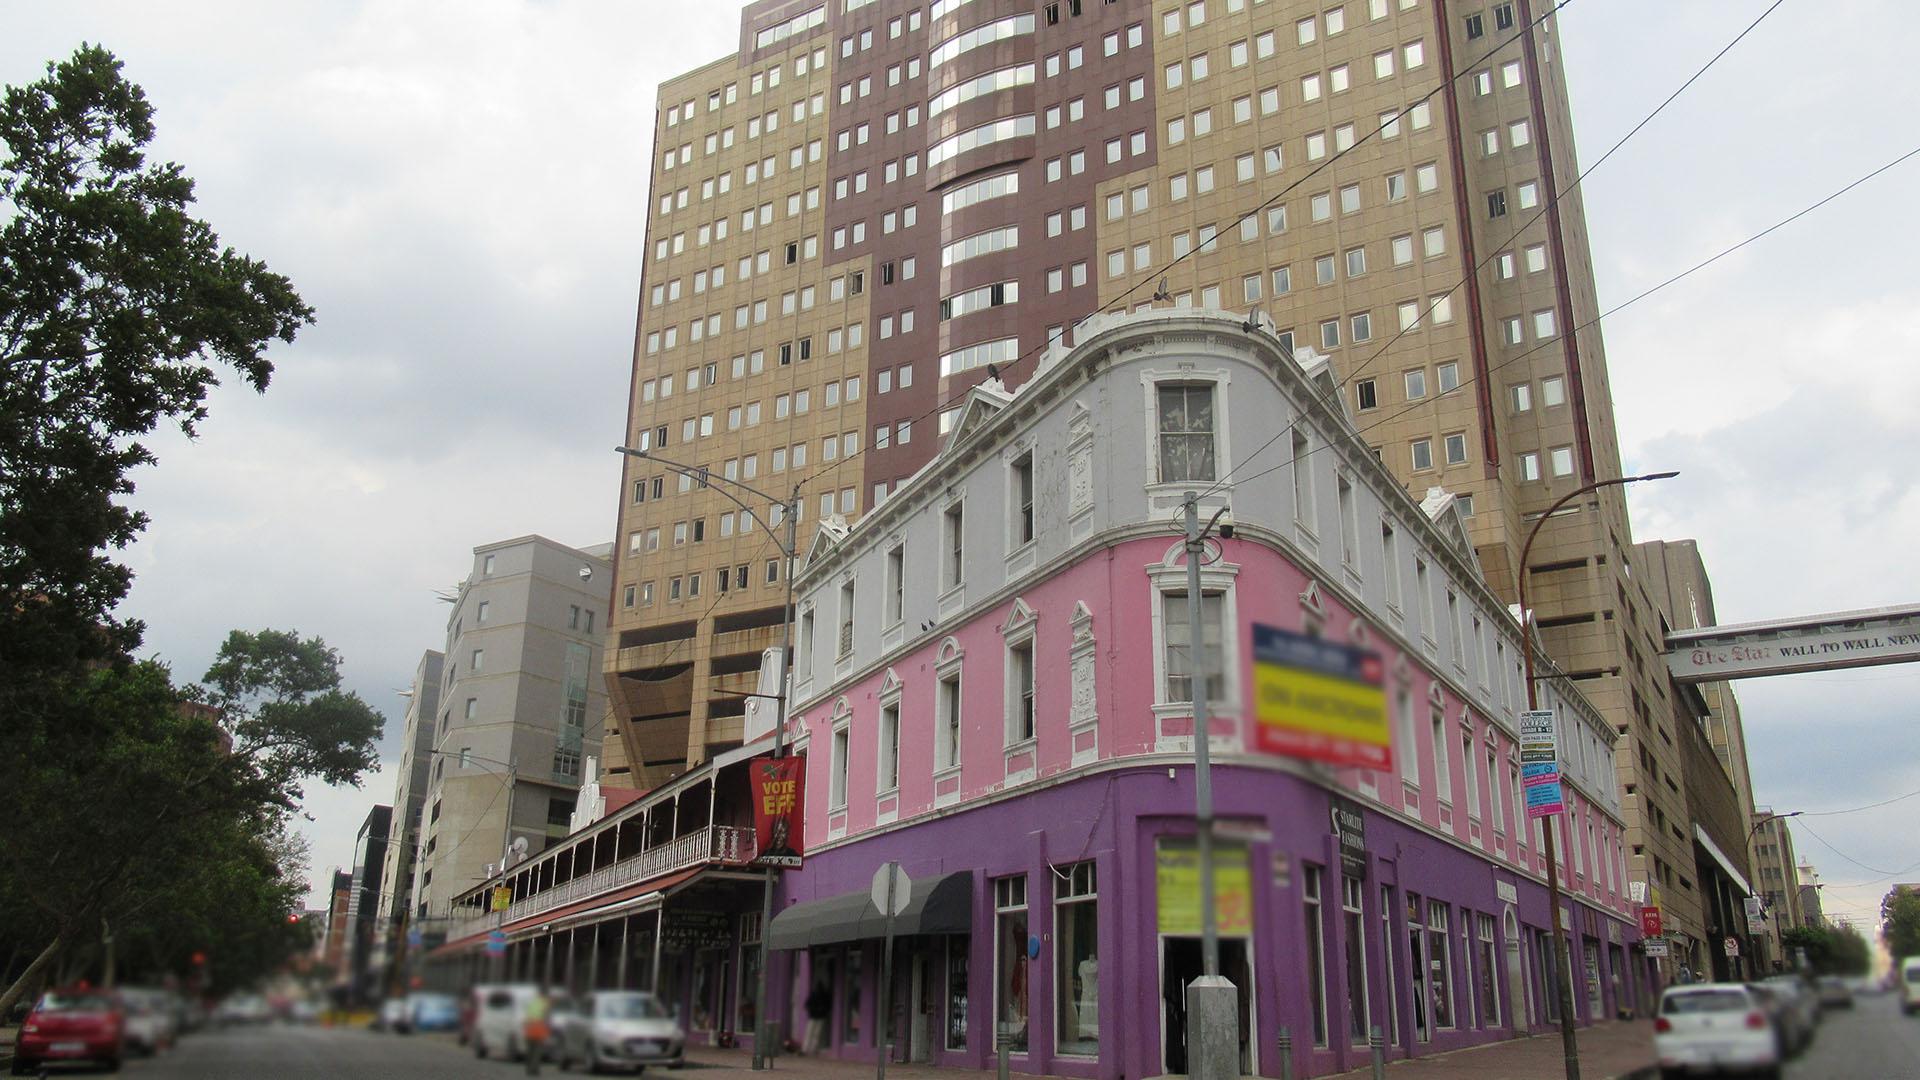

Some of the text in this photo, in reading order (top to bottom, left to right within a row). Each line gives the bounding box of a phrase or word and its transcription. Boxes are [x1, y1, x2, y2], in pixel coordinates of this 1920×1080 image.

[1780, 645, 1819, 657] WALL
[1821, 642, 1840, 653] TO
[1843, 637, 1884, 650] WALL
[762, 780, 796, 795] VOTE
[764, 794, 796, 815] EFF
[1341, 830, 1364, 851] FASHIONS
